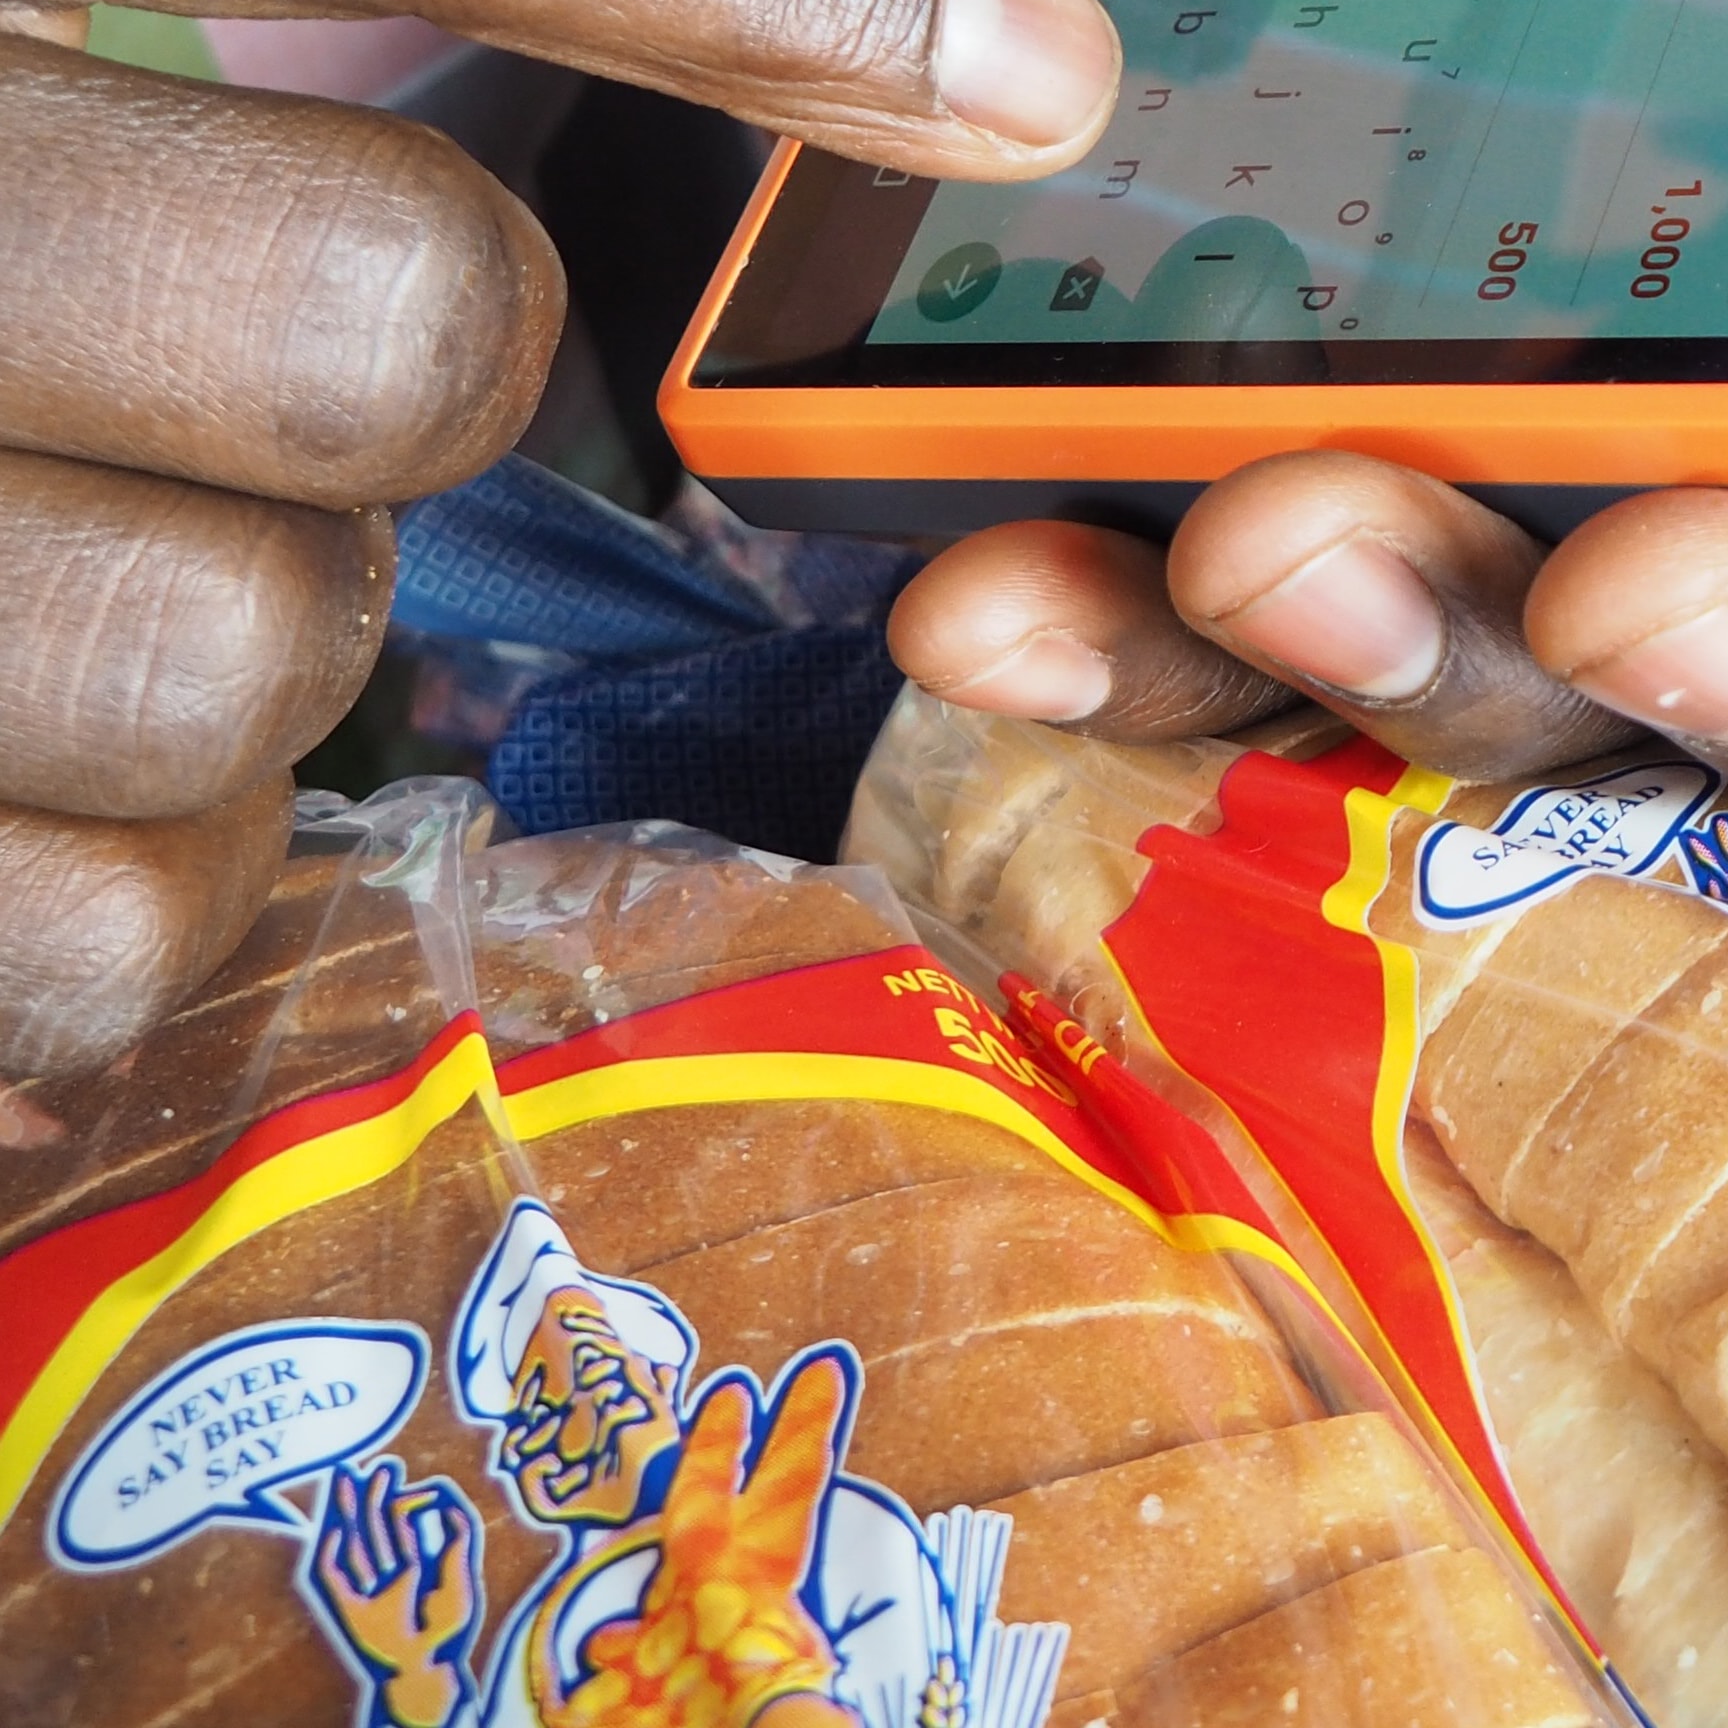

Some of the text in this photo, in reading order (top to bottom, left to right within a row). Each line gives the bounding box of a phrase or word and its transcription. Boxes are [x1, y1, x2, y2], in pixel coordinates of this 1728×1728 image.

[1173, 10, 1218, 35] b
[1293, 4, 1340, 29] h
[1401, 38, 1438, 62] u
[1136, 87, 1173, 112] n
[1253, 87, 1302, 101] j
[1371, 125, 1412, 136] i
[1098, 158, 1141, 200] m
[1224, 164, 1273, 189] k
[1337, 199, 1370, 226] o
[1629, 179, 1703, 300] 1,000
[1476, 221, 1539, 301] 500
[1297, 284, 1339, 312] p
[1529, 788, 1613, 841] VER
[1471, 837, 1531, 871] SA
[149, 1357, 303, 1447] NEVER
[116, 1380, 358, 1510] SAY BREAD
[205, 1429, 286, 1489] SAY
